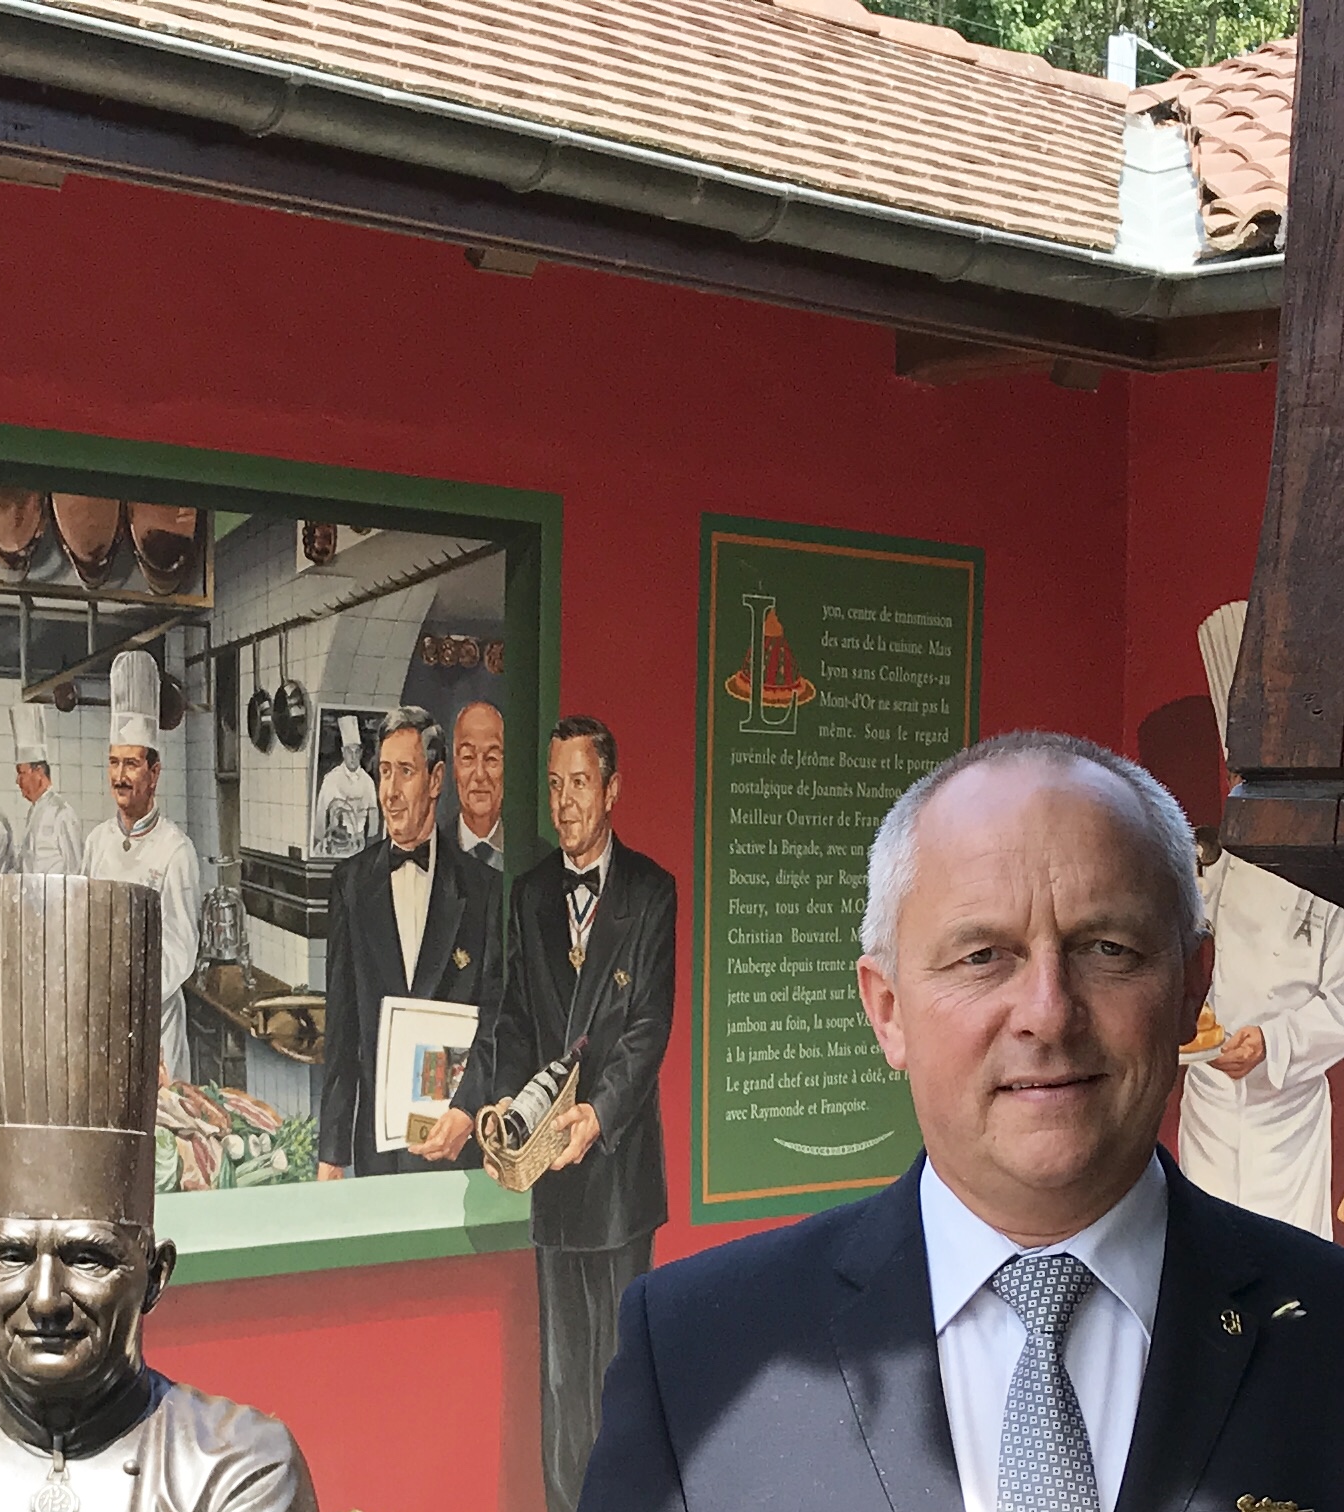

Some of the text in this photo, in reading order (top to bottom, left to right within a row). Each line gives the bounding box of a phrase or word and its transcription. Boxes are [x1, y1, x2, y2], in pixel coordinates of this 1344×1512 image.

[822, 605, 844, 620] yon,
[847, 608, 876, 621] centre
[879, 605, 892, 622] de
[895, 610, 952, 628] transmission
[821, 630, 838, 647] des
[841, 637, 860, 649] arts
[863, 634, 874, 651] de
[877, 634, 886, 651] la
[928, 640, 952, 657] Mais
[821, 660, 951, 688] Lyon sans Collonges-au
[819, 690, 950, 717] Mont-d'Or ne serait pas la
[819, 722, 949, 746] même. Sous le regard
[730, 748, 776, 766] juvénile
[780, 749, 794, 766] de
[795, 750, 835, 770] Jérôme
[839, 751, 877, 769] Bocuse
[880, 756, 891, 769] et
[894, 753, 904, 770] le
[730, 778, 794, 799] nostalgique
[796, 779, 809, 796] de
[811, 780, 854, 800] Joannès
[730, 808, 783, 826] Meilleur
[786, 809, 834, 826] Ouvrier
[837, 811, 850, 827] de
[729, 838, 766, 855] s'active
[769, 839, 778, 855] la
[781, 839, 824, 859] Brigade,
[826, 846, 847, 856] avec
[850, 845, 864, 856] un
[729, 868, 770, 887] Bocuse,
[776, 869, 810, 889] dirigée
[816, 874, 833, 889] par
[728, 898, 768, 918] Fleury,
[776, 902, 800, 914] tous
[806, 898, 833, 914] deux
[727, 927, 783, 944] Christian
[791, 927, 842, 943] Bouvarel.
[727, 956, 777, 977] l'Auberge
[780, 956, 813, 977] depuis
[817, 959, 845, 972] trente
[727, 984, 856, 1007] jette un oeil élégant sur le
[726, 1016, 767, 1037] jambon
[770, 1020, 782, 1031] au
[785, 1014, 810, 1032] foin,
[814, 1013, 823, 1029] la
[826, 1016, 854, 1032] soupe
[726, 1047, 732, 1063] à
[736, 1046, 745, 1062] la
[748, 1044, 780, 1064] jambe
[783, 1043, 795, 1059] de
[799, 1043, 824, 1059] bois.
[827, 1041, 852, 1057] Mais
[854, 1040, 868, 1055] où
[726, 1077, 739, 1092] Le
[743, 1073, 775, 1095] grand
[778, 1071, 803, 1089] chef
[804, 1074, 820, 1087] est
[822, 1071, 848, 1089] juste
[851, 1069, 858, 1084] à
[860, 1068, 886, 1084] côté,
[889, 1070, 901, 1081] en
[725, 1098, 869, 1122] avec Raymonde et Françoise.
